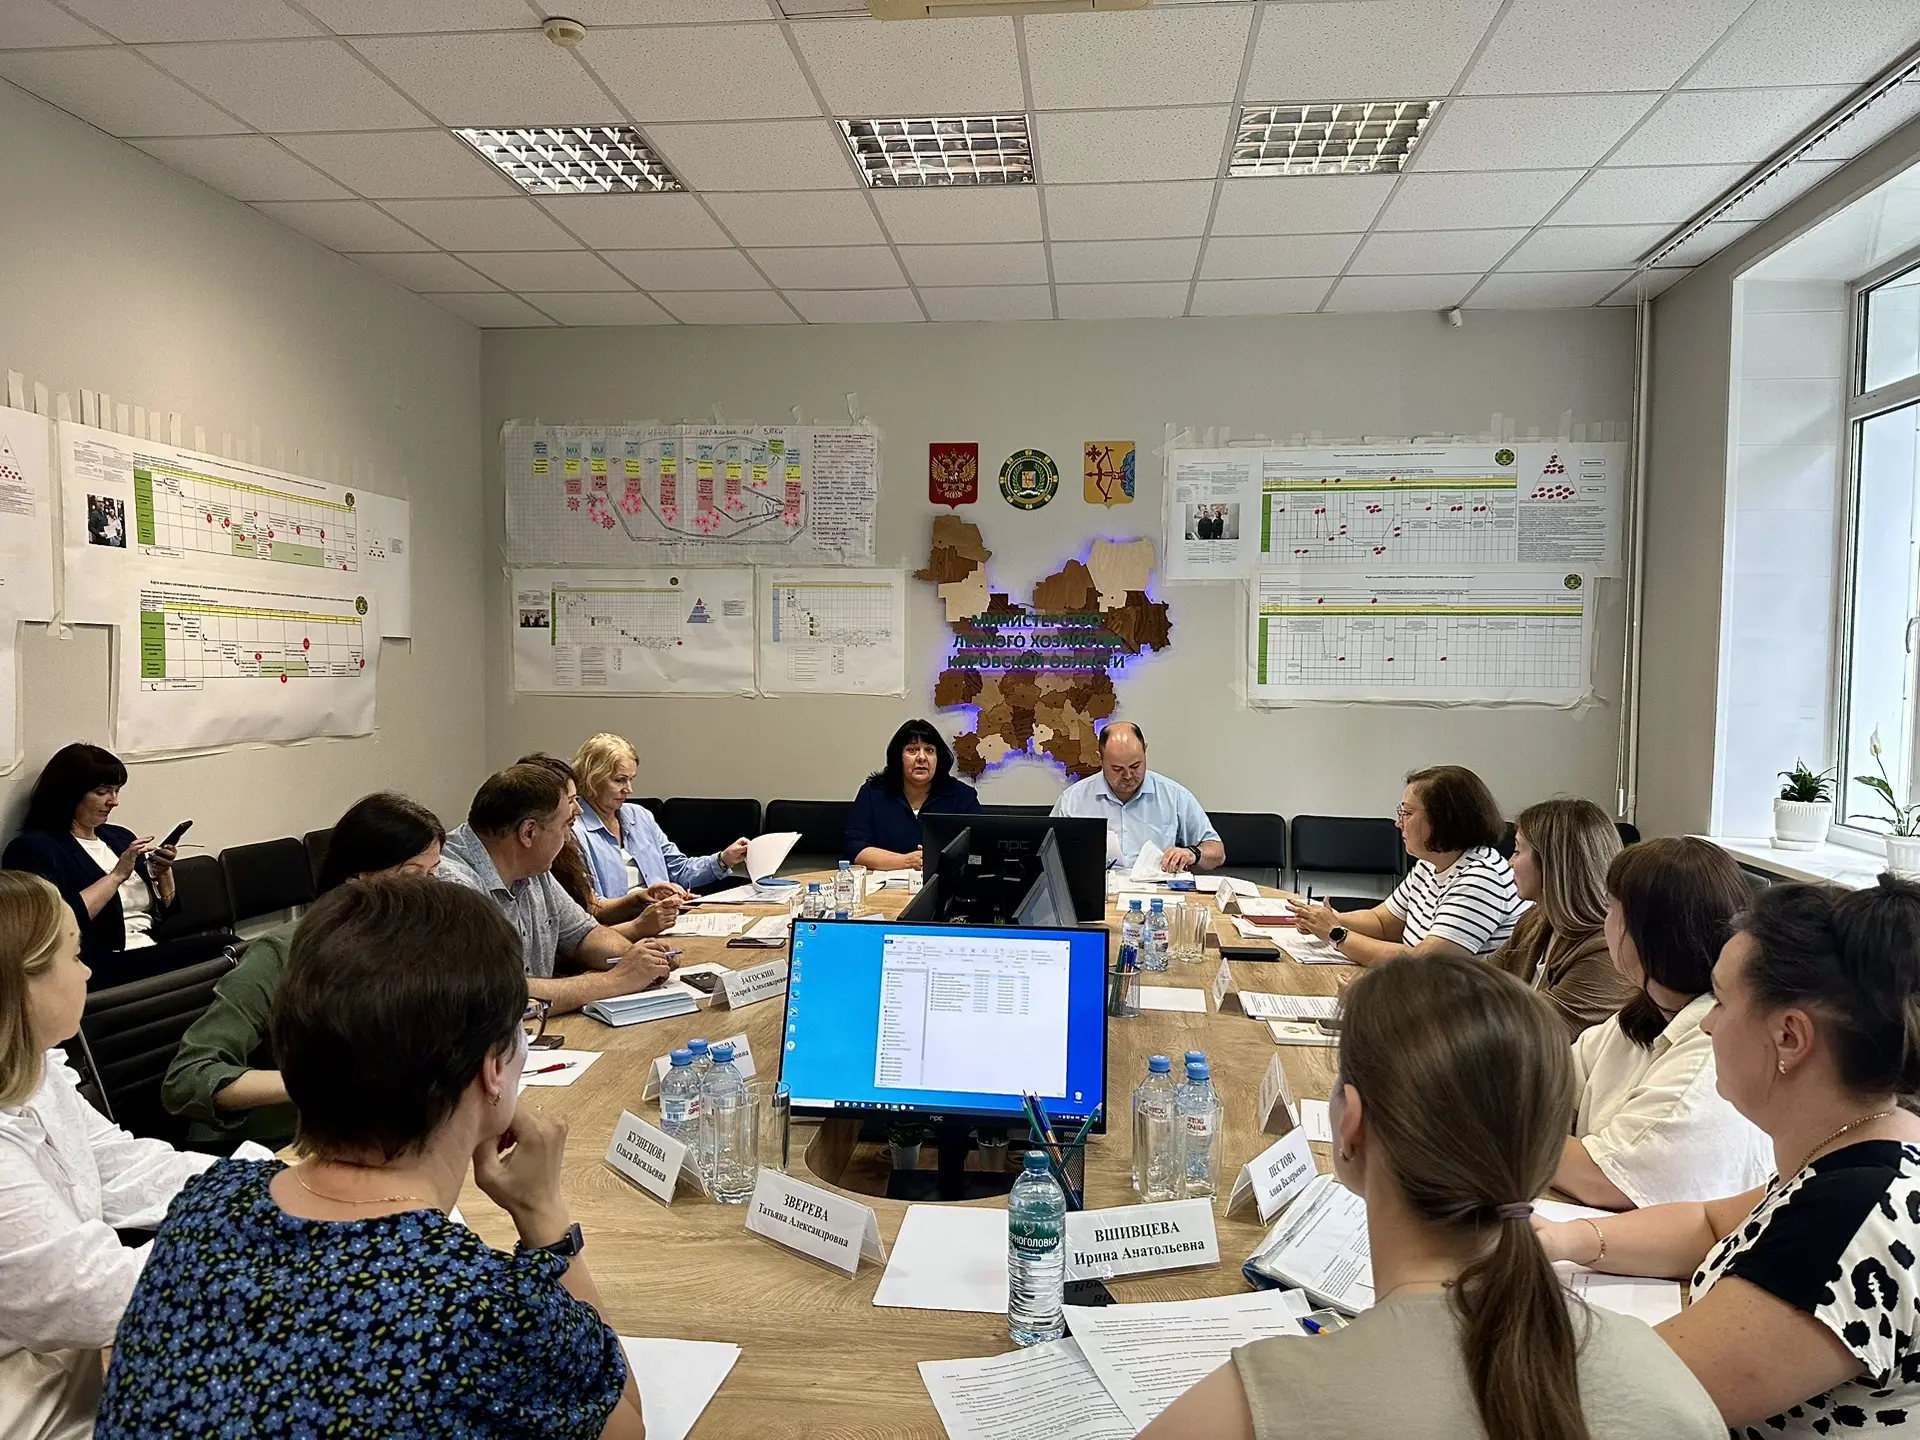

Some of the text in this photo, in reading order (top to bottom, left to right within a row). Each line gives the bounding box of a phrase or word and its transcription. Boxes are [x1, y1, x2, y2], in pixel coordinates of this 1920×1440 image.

[971, 614, 1102, 628] МИНИСТЕРСТВО
[952, 633, 1123, 648] ЛЕСНОГО ХОЗЯЙСТВА
[947, 654, 1125, 669] КИРОВСКОЙ ОБЛАСТИ
[741, 969, 775, 985] ЗАГОСКИН
[627, 1130, 666, 1163] КУЗНЕЦОВА
[616, 1144, 666, 1183] Ольга Васильевна
[1268, 1152, 1297, 1178] ПЕСТОВА
[1269, 1163, 1307, 1198] Анна Валерьевна
[783, 1193, 828, 1222] ЗВЕРЕВА
[759, 1202, 849, 1248] Татьяна Александровна
[1094, 1220, 1180, 1243] ВШИВЦЕВА
[1009, 1231, 1058, 1248] ЕРНОГОЛОВКА
[1074, 1240, 1205, 1267] Ирина Анатольевна
